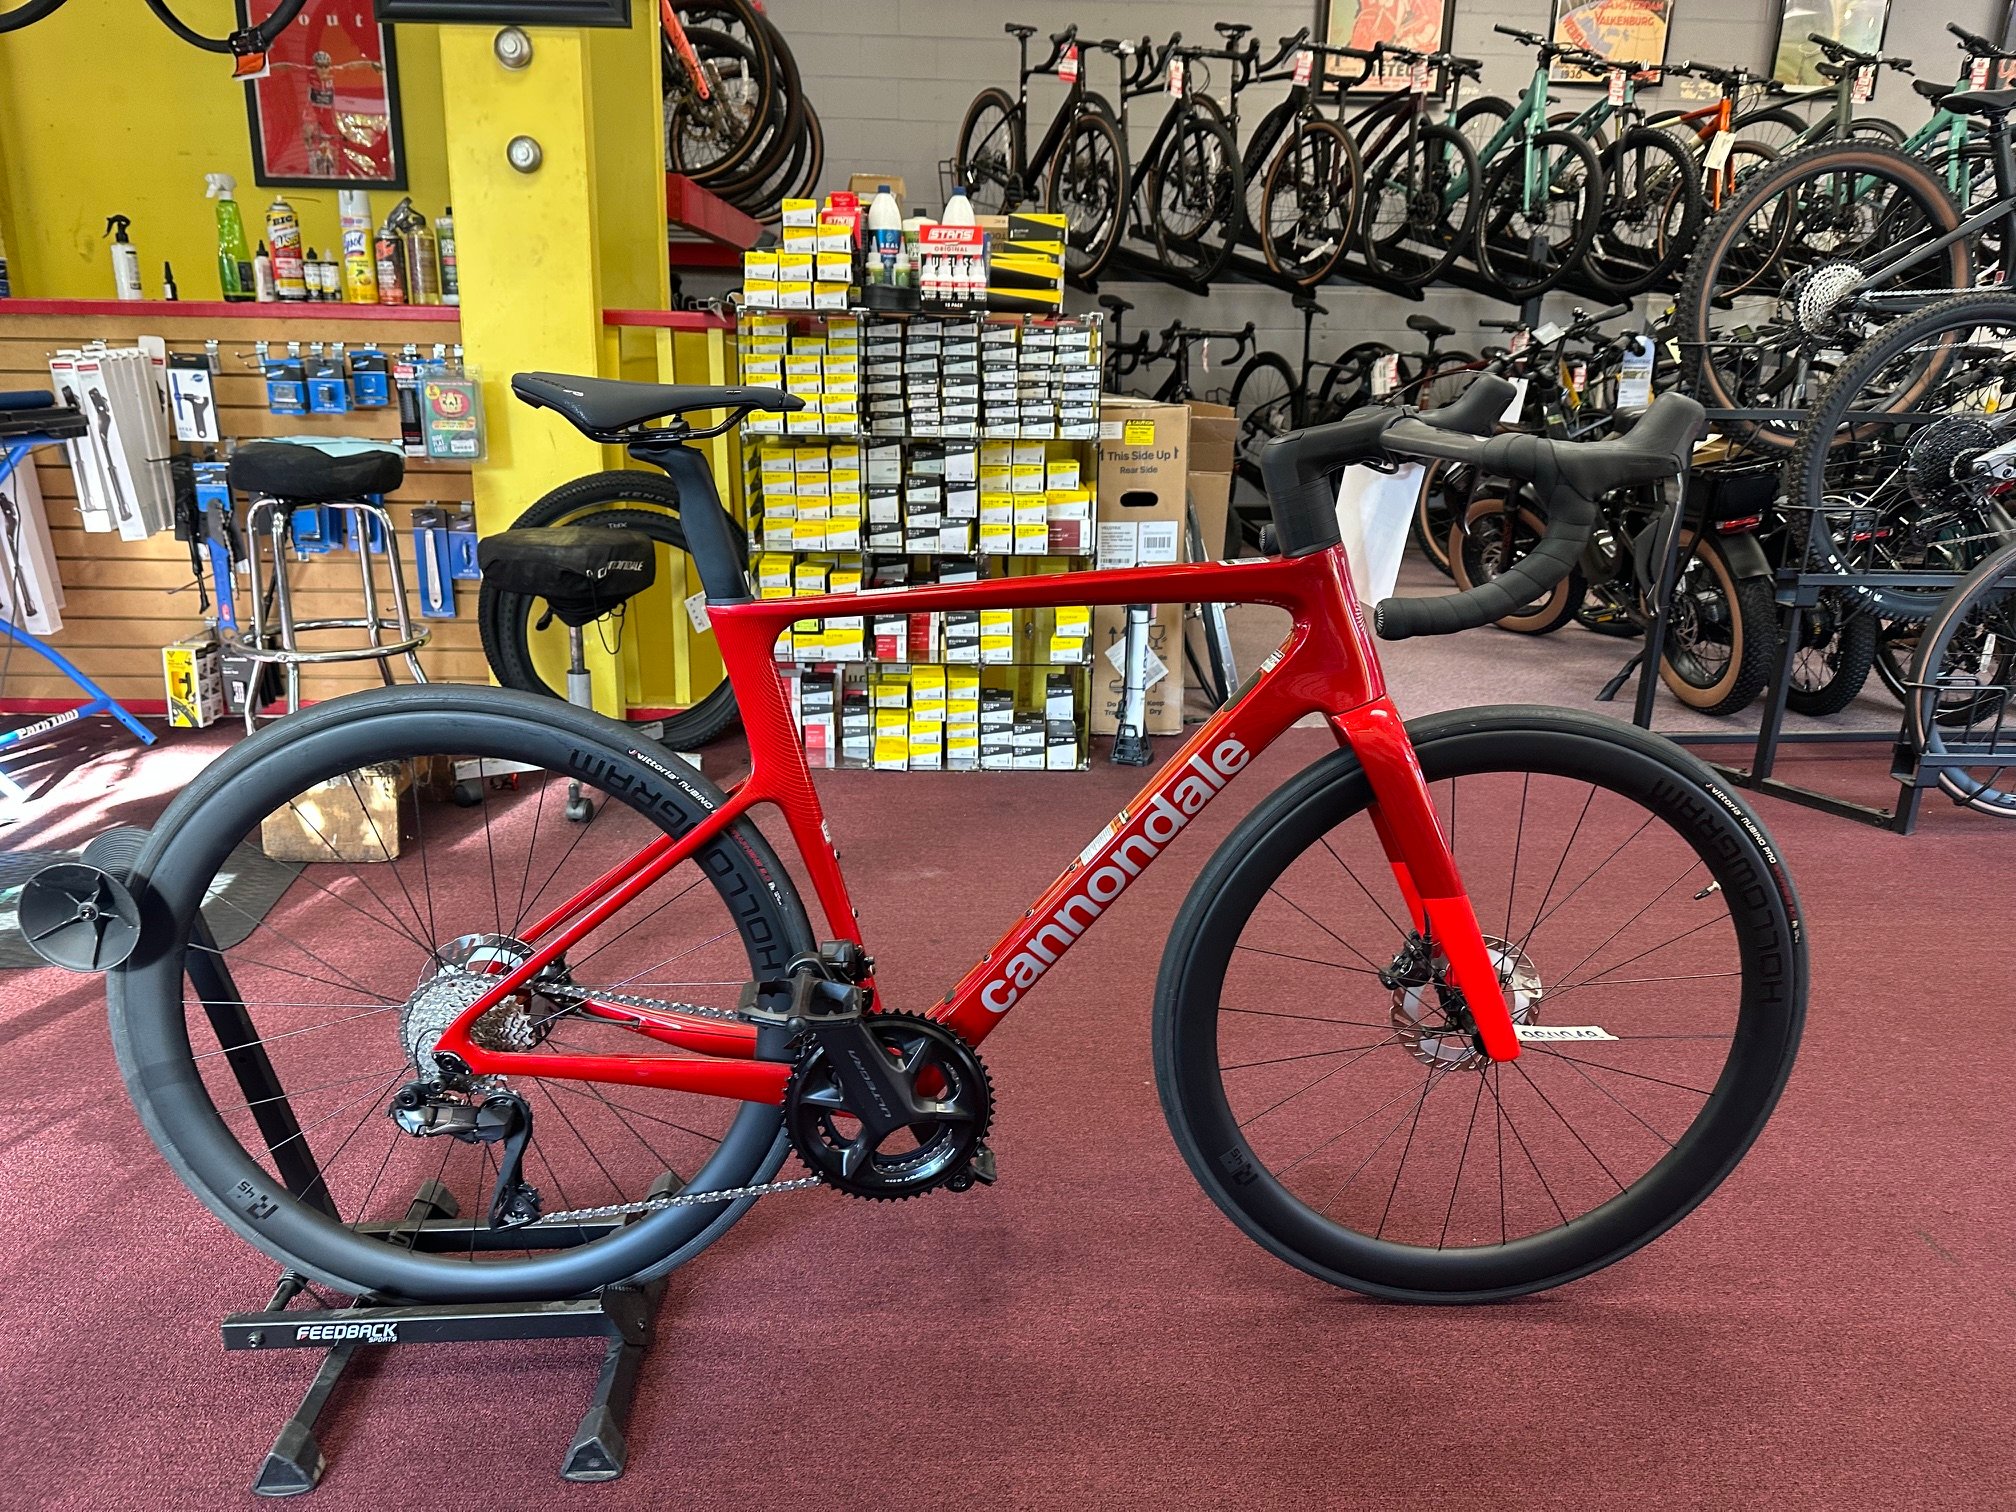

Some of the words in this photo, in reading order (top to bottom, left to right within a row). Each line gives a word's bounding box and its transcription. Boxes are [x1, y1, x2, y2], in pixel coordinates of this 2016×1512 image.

[1108, 451, 1129, 461] This
[1132, 450, 1154, 461] Side
[1156, 450, 1171, 462] Up
[1120, 466, 1138, 474] Rear
[1140, 465, 1158, 474] Side
[636, 751, 677, 781] vittoria
[677, 779, 715, 811] RUBINO
[1711, 785, 1741, 816] vittoria
[1740, 816, 1767, 847] RUBINO
[980, 737, 1251, 1014] cannondale
[296, 1322, 398, 1341] FEEDBACK
[368, 1335, 398, 1343] SPORTS
